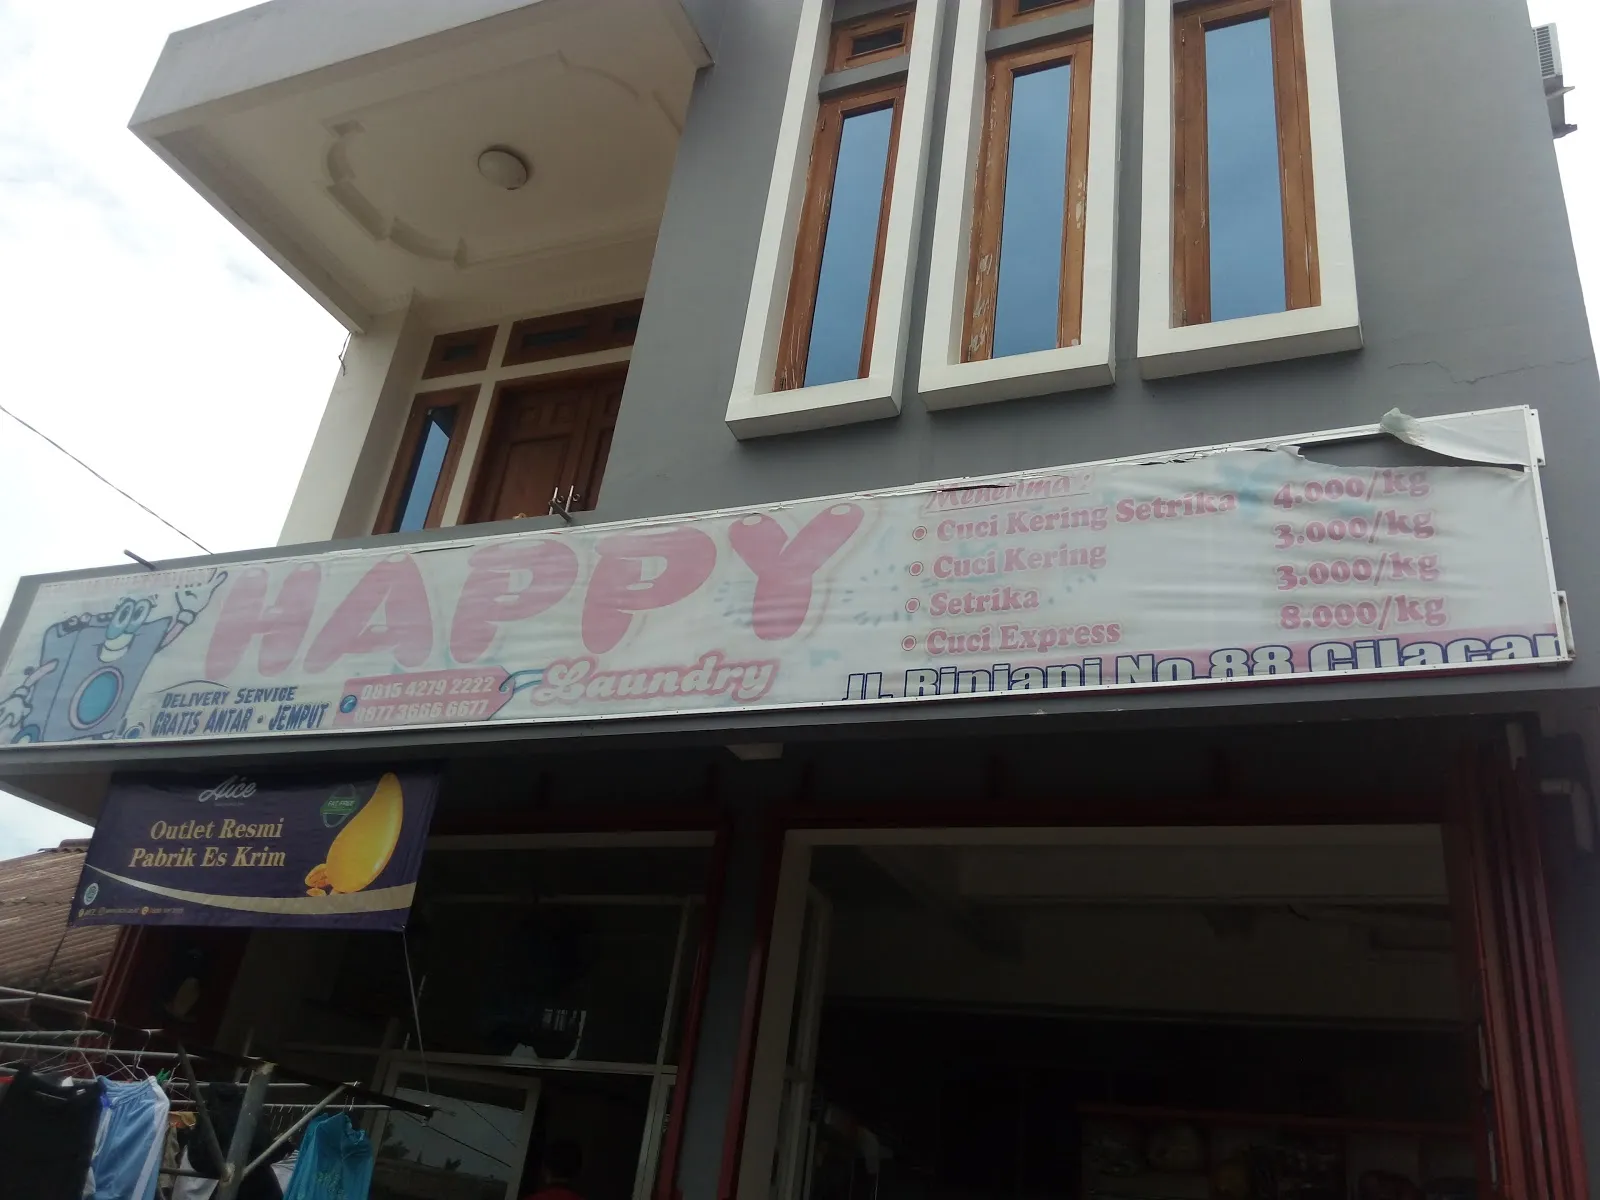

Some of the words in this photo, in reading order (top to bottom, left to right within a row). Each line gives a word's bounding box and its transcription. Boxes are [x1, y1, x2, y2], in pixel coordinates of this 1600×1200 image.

[1273, 468, 1432, 510] 4.000/kg
[936, 514, 999, 542] Cuci
[1005, 506, 1109, 535] Kering
[1115, 492, 1236, 523] Setrika
[1274, 510, 1436, 549] 3.000/kg
[932, 550, 997, 579] Cuci
[1003, 543, 1107, 572] Kering
[1276, 552, 1440, 591] 3.000/kg
[205, 502, 865, 680] HAPPY
[929, 586, 1039, 617] Setrika
[1279, 595, 1447, 631] 8.000/kg
[926, 625, 992, 656] Cuci
[1000, 621, 1121, 653] Express
[361, 683, 402, 700] 0815
[405, 679, 447, 696] 4279
[450, 676, 495, 694] 2222
[541, 657, 773, 701] Laundry
[904, 657, 1103, 698] Rinjani
[162, 690, 231, 708] DELIVERY
[234, 686, 298, 704] SERVICE
[152, 711, 203, 736] GRATIS
[203, 707, 254, 733] ANTAR
[268, 703, 330, 730] JEMPUT
[150, 820, 215, 840] Outlet
[219, 818, 284, 838] Resmi
[128, 847, 195, 868] Pabrik
[200, 848, 227, 867] Es
[232, 846, 286, 867] Krim
